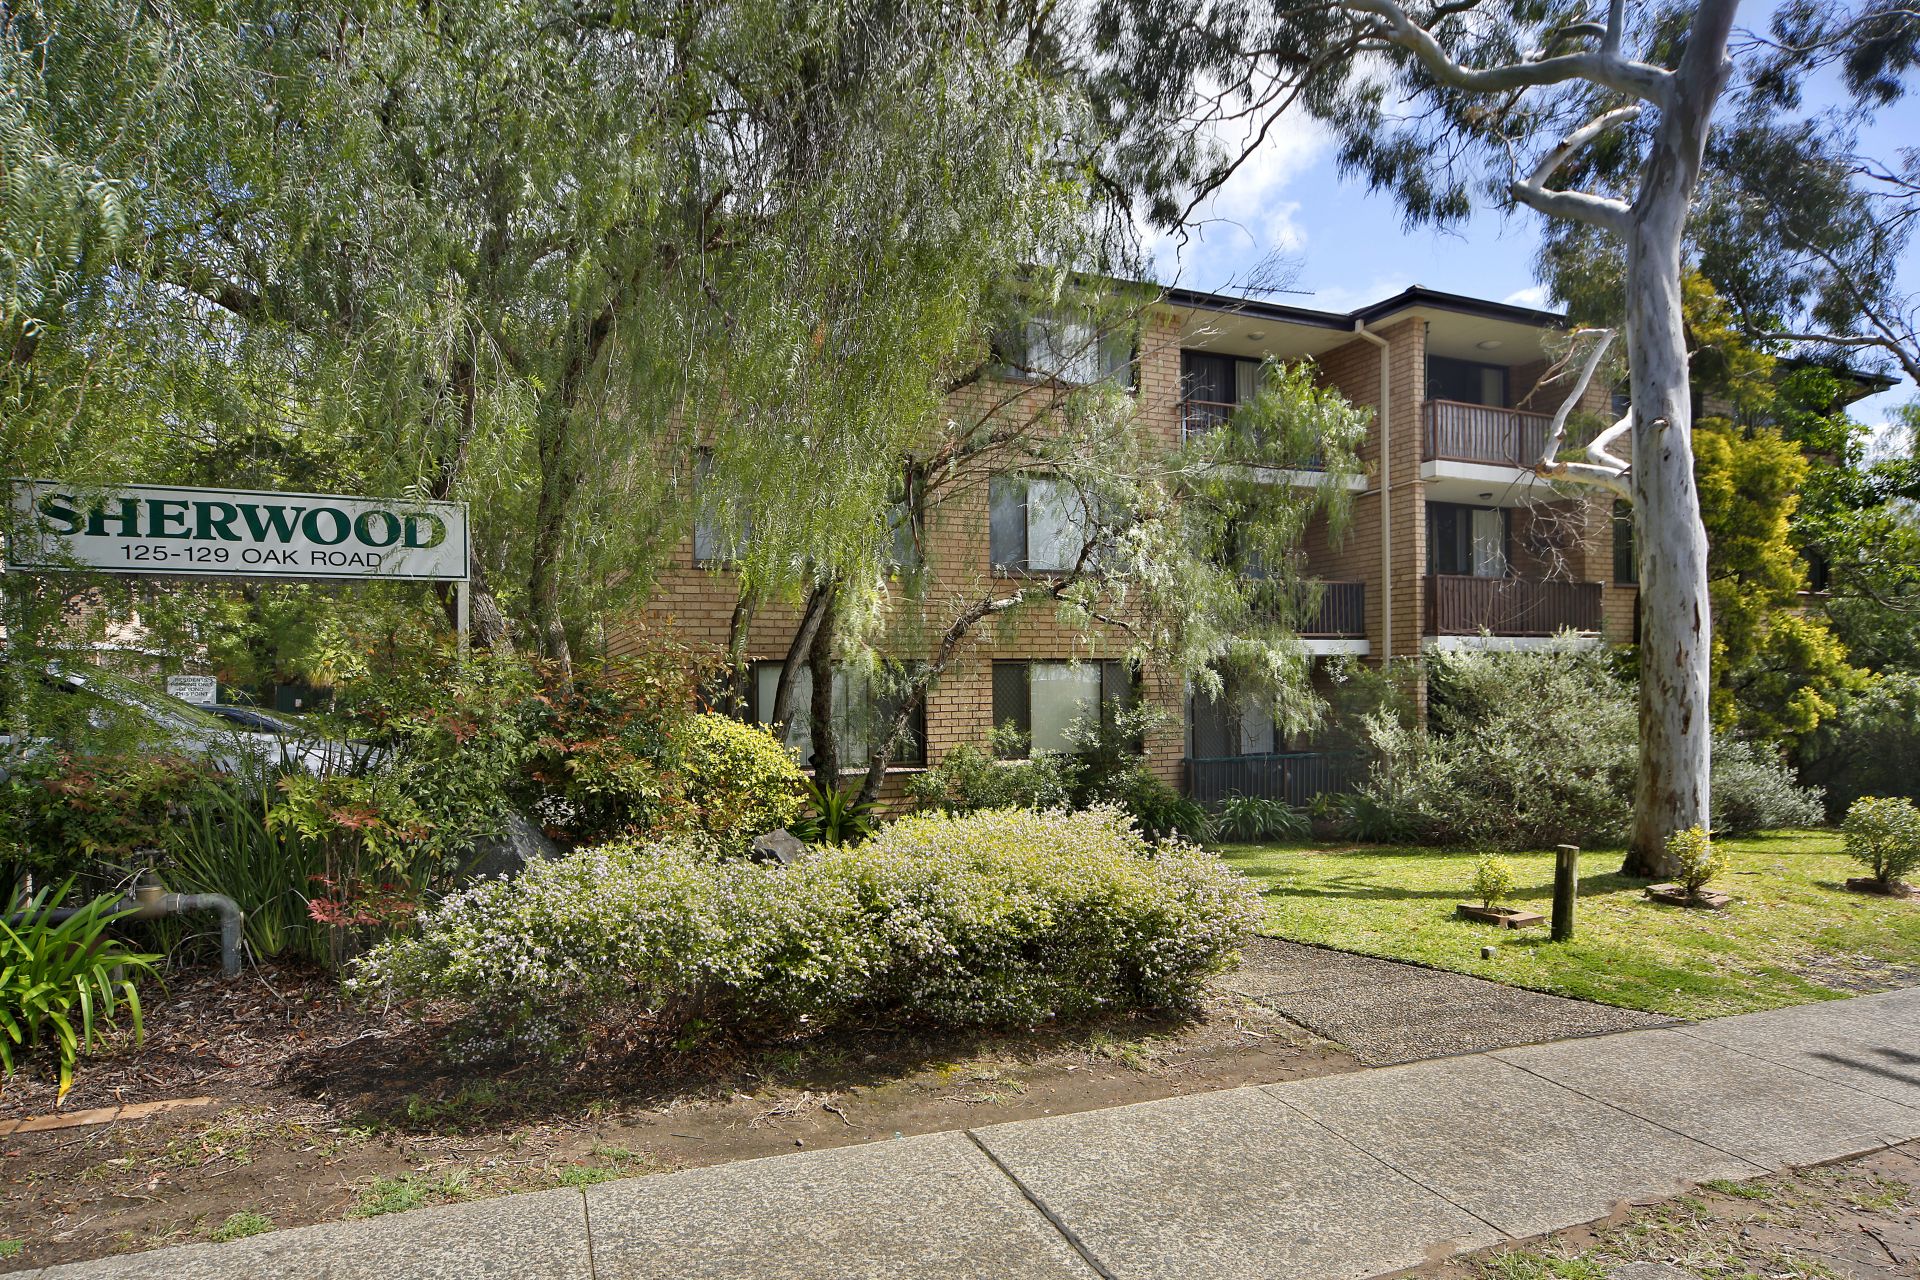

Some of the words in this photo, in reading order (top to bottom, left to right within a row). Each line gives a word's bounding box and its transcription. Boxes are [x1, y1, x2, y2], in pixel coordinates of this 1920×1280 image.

[38, 493, 447, 549] SHERWOOD
[120, 545, 230, 563] 125-129
[241, 548, 300, 565] OAK
[311, 551, 382, 568] ROAD
